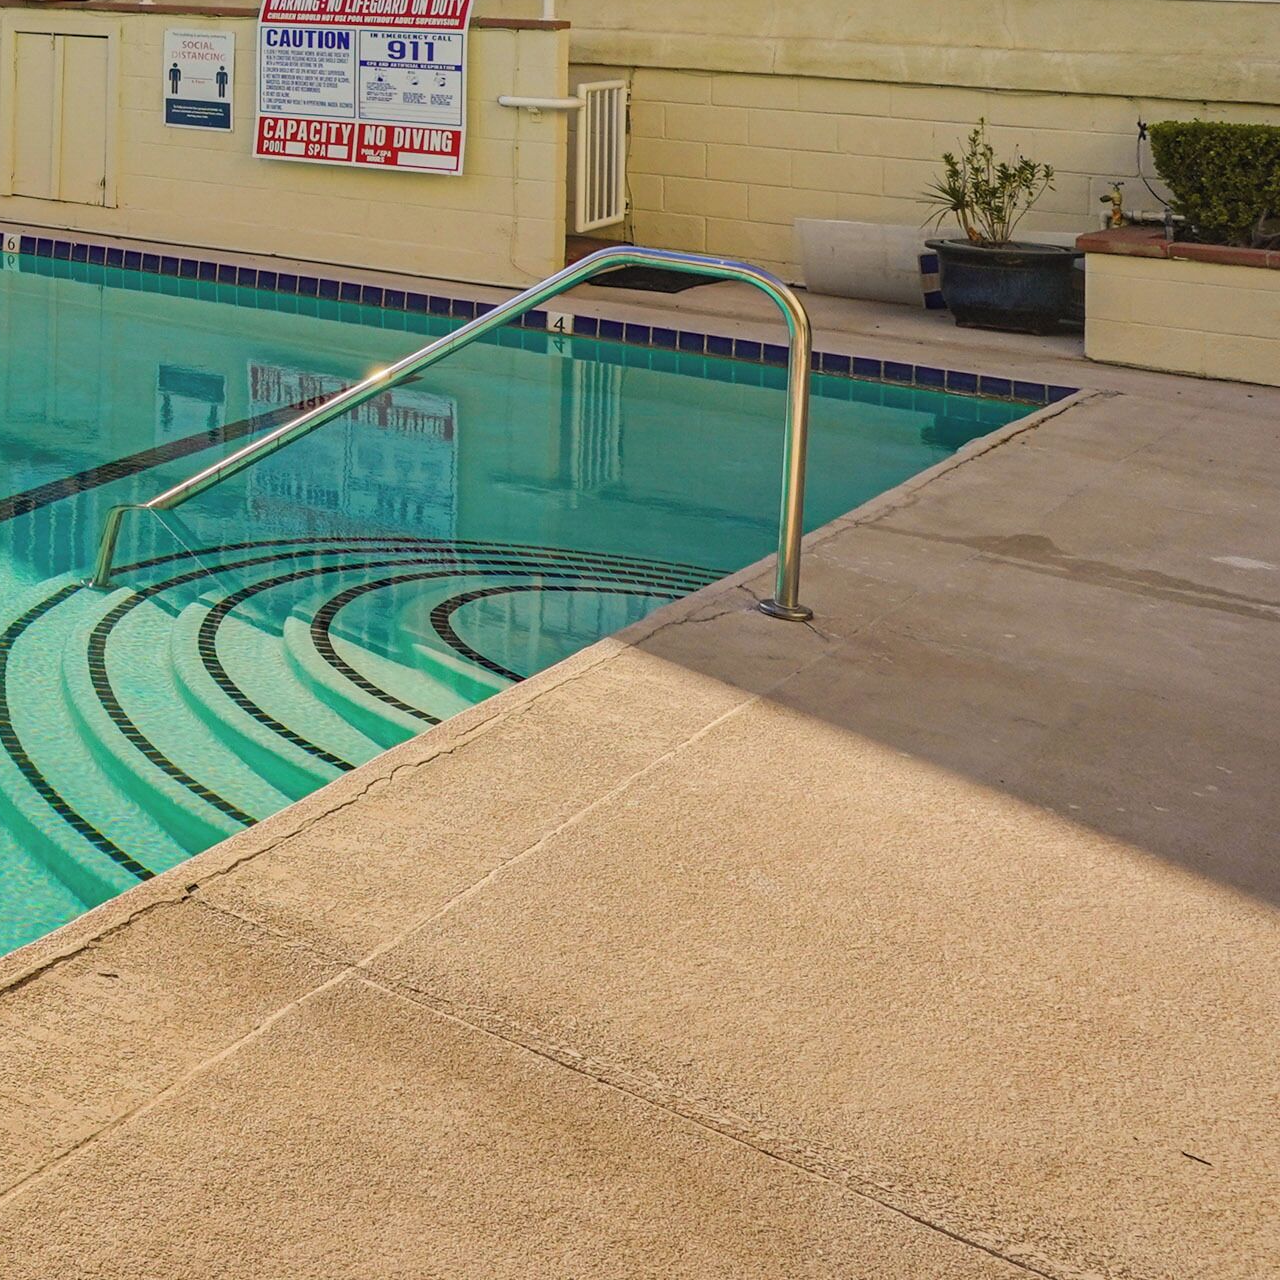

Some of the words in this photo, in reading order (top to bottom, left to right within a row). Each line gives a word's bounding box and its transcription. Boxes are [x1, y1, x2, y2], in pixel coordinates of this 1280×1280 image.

[267, 12, 296, 20] CHILDREN
[297, 13, 321, 21] SHOULD
[334, 14, 346, 22] USE
[364, 16, 394, 24] WITHOUT
[415, 18, 460, 26] SUPERVISION
[182, 41, 214, 50] SOCIAL
[266, 29, 350, 49] CAUTION
[387, 40, 434, 61] 911
[263, 119, 352, 144] CAPACITY
[364, 125, 386, 146] NO
[393, 127, 453, 152] DIVING
[263, 140, 285, 153] POOL
[308, 144, 326, 157] SPA
[8, 236, 15, 250] 6
[553, 316, 565, 334] 4
